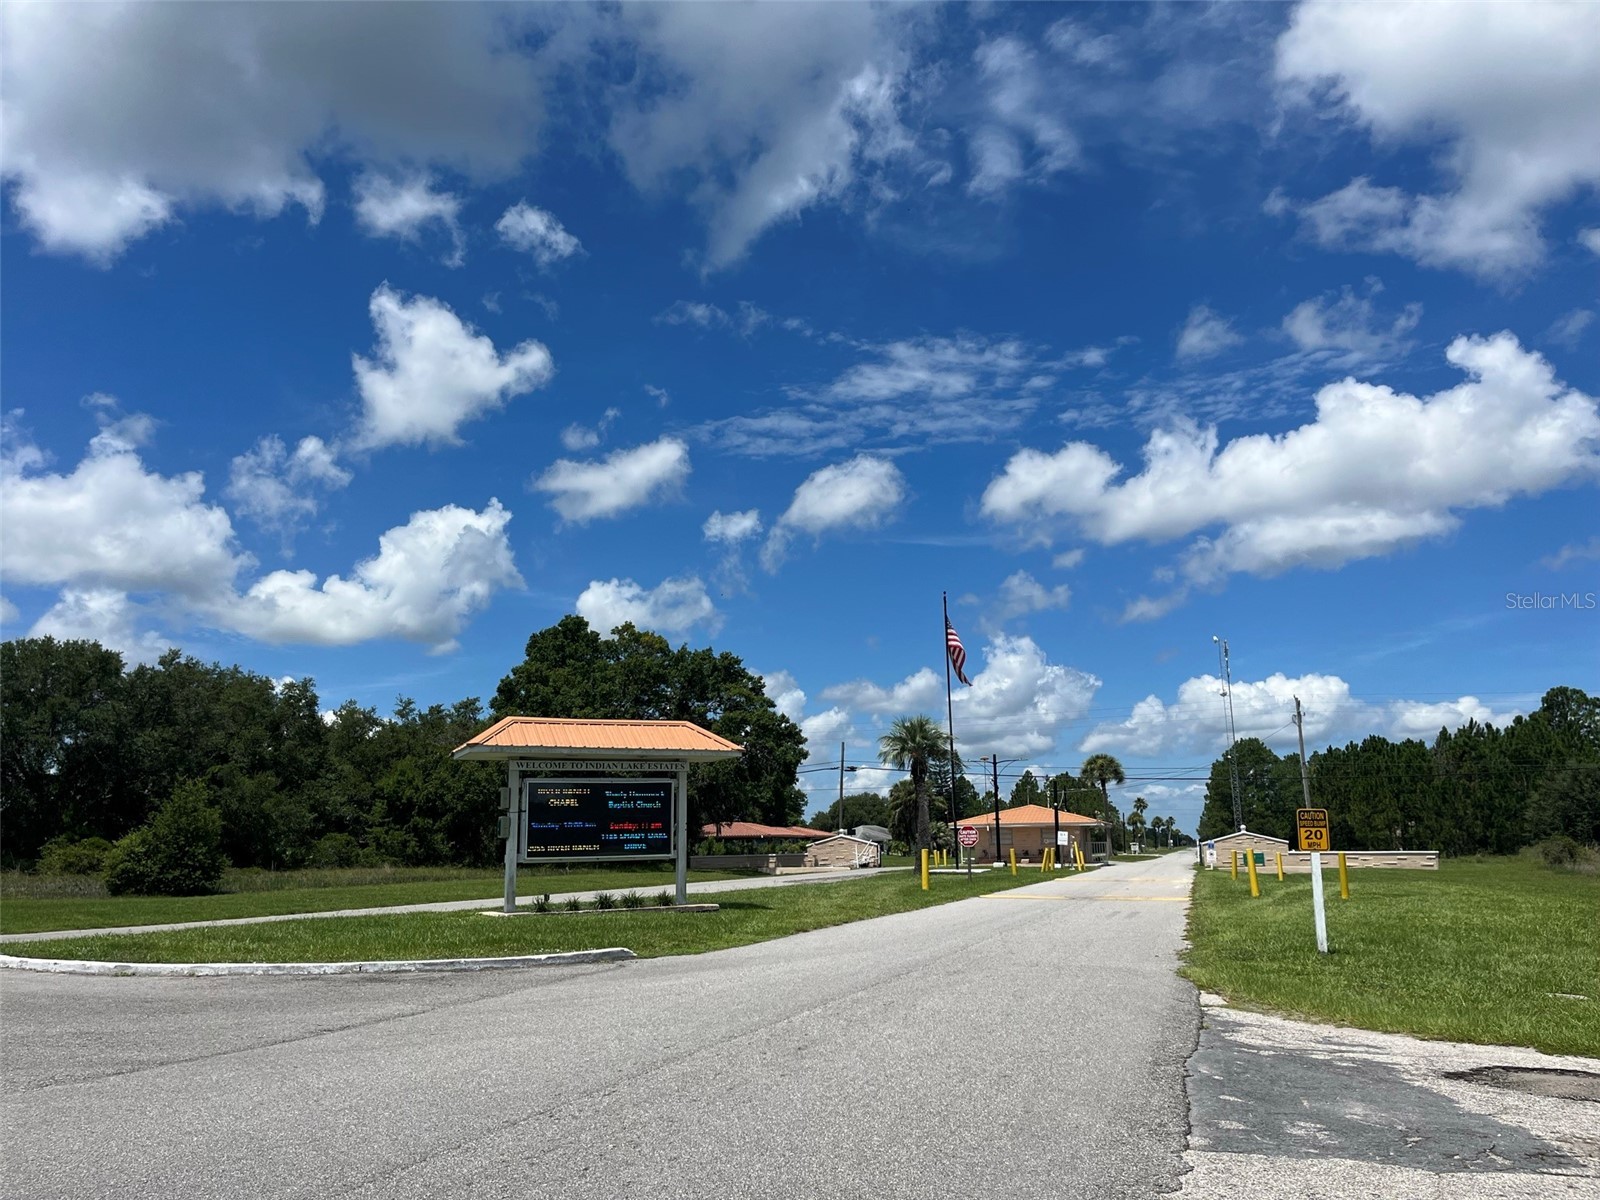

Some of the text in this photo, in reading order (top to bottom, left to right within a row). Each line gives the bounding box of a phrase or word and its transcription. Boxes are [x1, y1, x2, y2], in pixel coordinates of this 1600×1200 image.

[516, 761, 567, 769] WELCOME
[570, 761, 583, 769] TO
[648, 762, 685, 770] ESTATES
[548, 798, 579, 807] CHAPEL
[1300, 812, 1324, 820] CAUTION
[1304, 830, 1323, 840] 20
